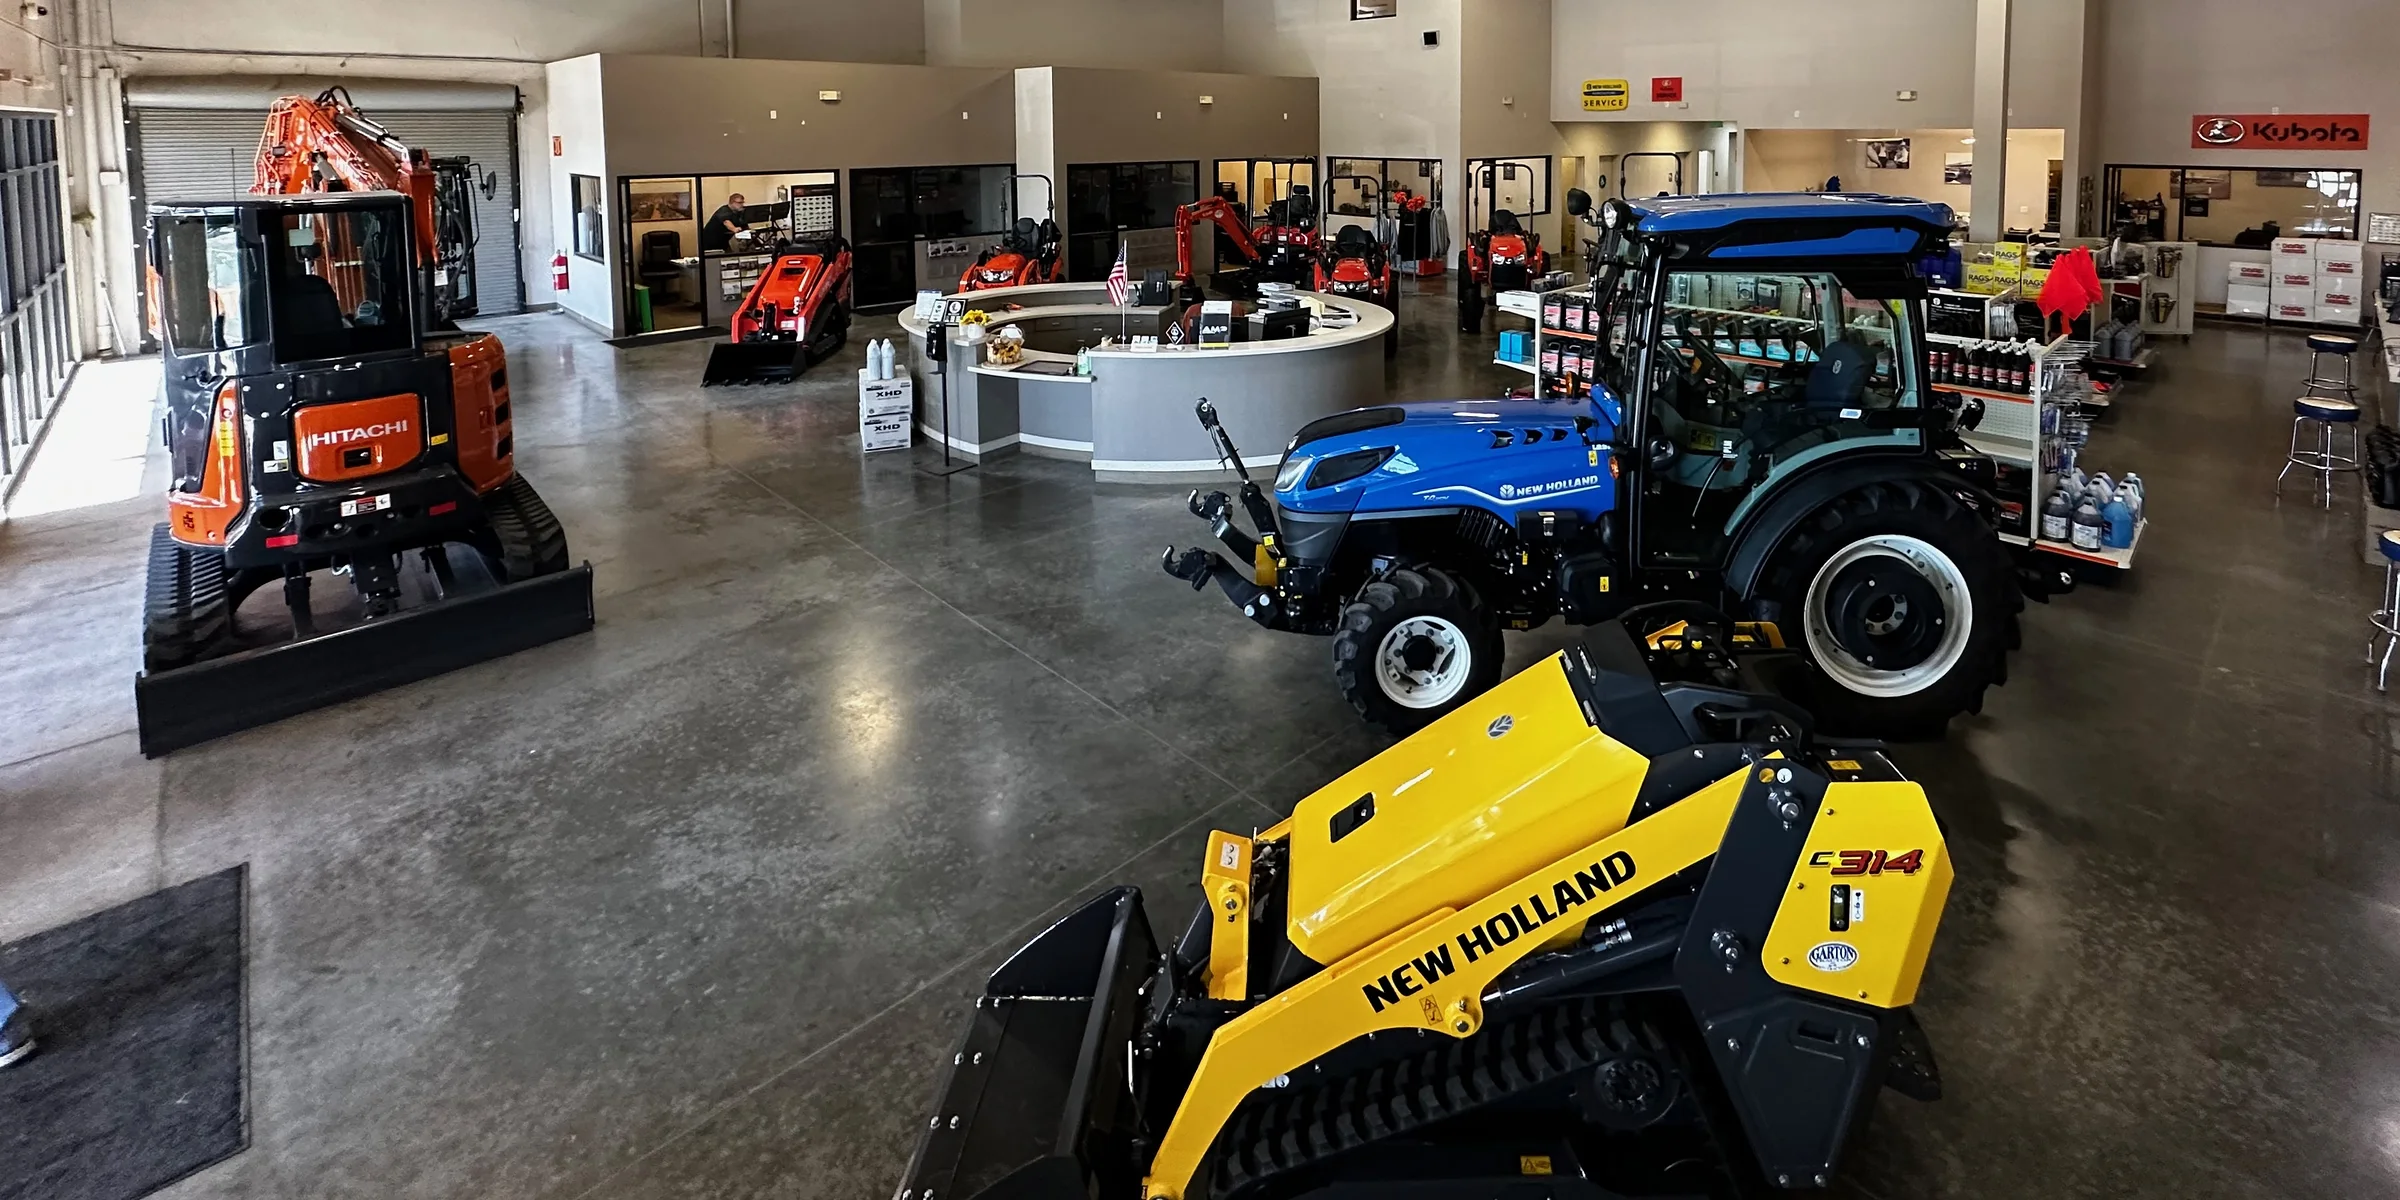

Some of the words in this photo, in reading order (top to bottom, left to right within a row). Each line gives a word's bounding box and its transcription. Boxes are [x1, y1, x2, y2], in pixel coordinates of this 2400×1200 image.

[1583, 99, 1624, 107] SERVICE
[2252, 122, 2361, 142] Kubota
[1994, 276, 2017, 284] RAGS
[875, 389, 903, 398] XHD
[312, 419, 408, 447] HITACHI
[874, 423, 901, 432] XHD
[1516, 486, 1544, 497] NEW
[1545, 475, 1599, 491] HOLLAND
[1809, 849, 1924, 876] C314
[1361, 943, 1456, 1013] NEW
[1455, 850, 1637, 963] HOLLAND
[1810, 946, 1855, 961] GARTON
